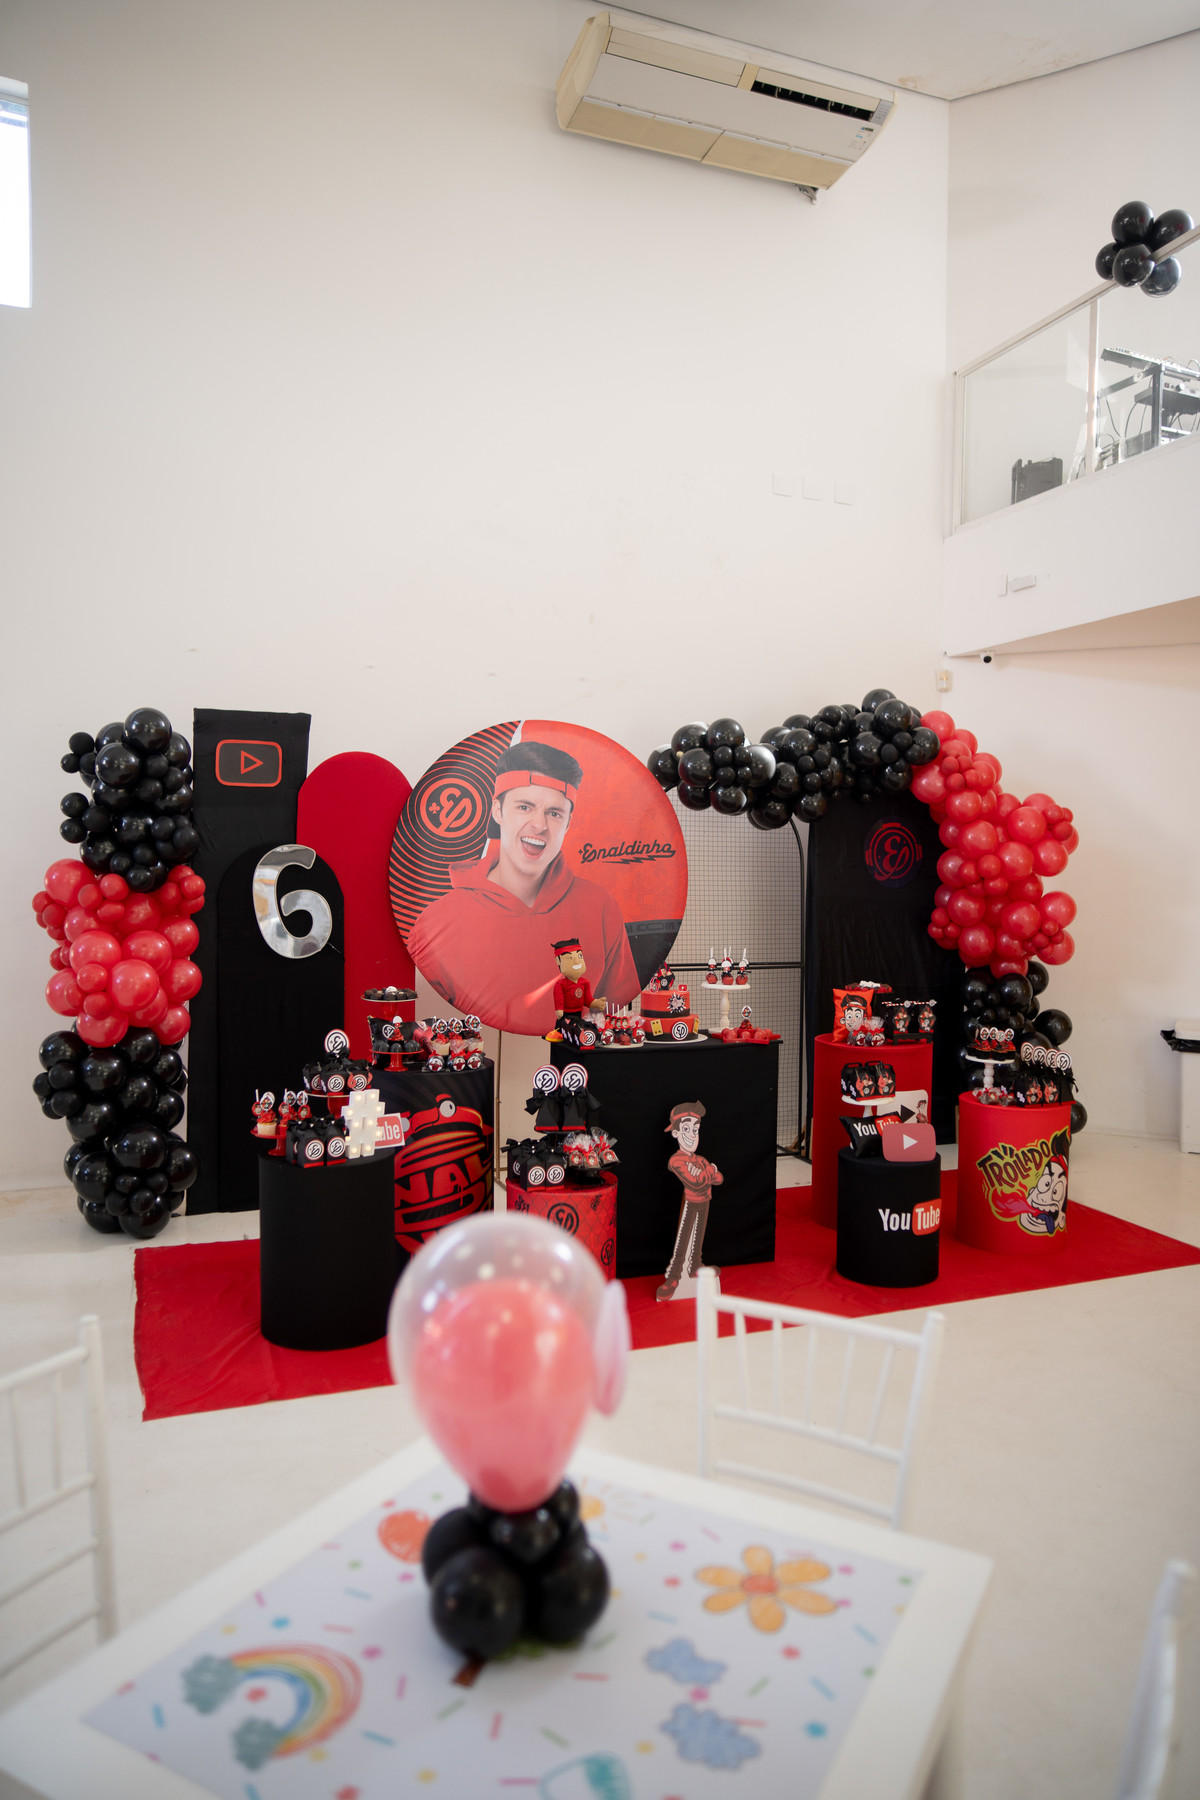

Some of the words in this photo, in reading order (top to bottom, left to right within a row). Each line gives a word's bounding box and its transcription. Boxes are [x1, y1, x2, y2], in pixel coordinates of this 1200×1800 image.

[580, 839, 677, 865] Enaldinho
[252, 844, 333, 959] 6
[977, 1140, 1051, 1189] TROLLADO
